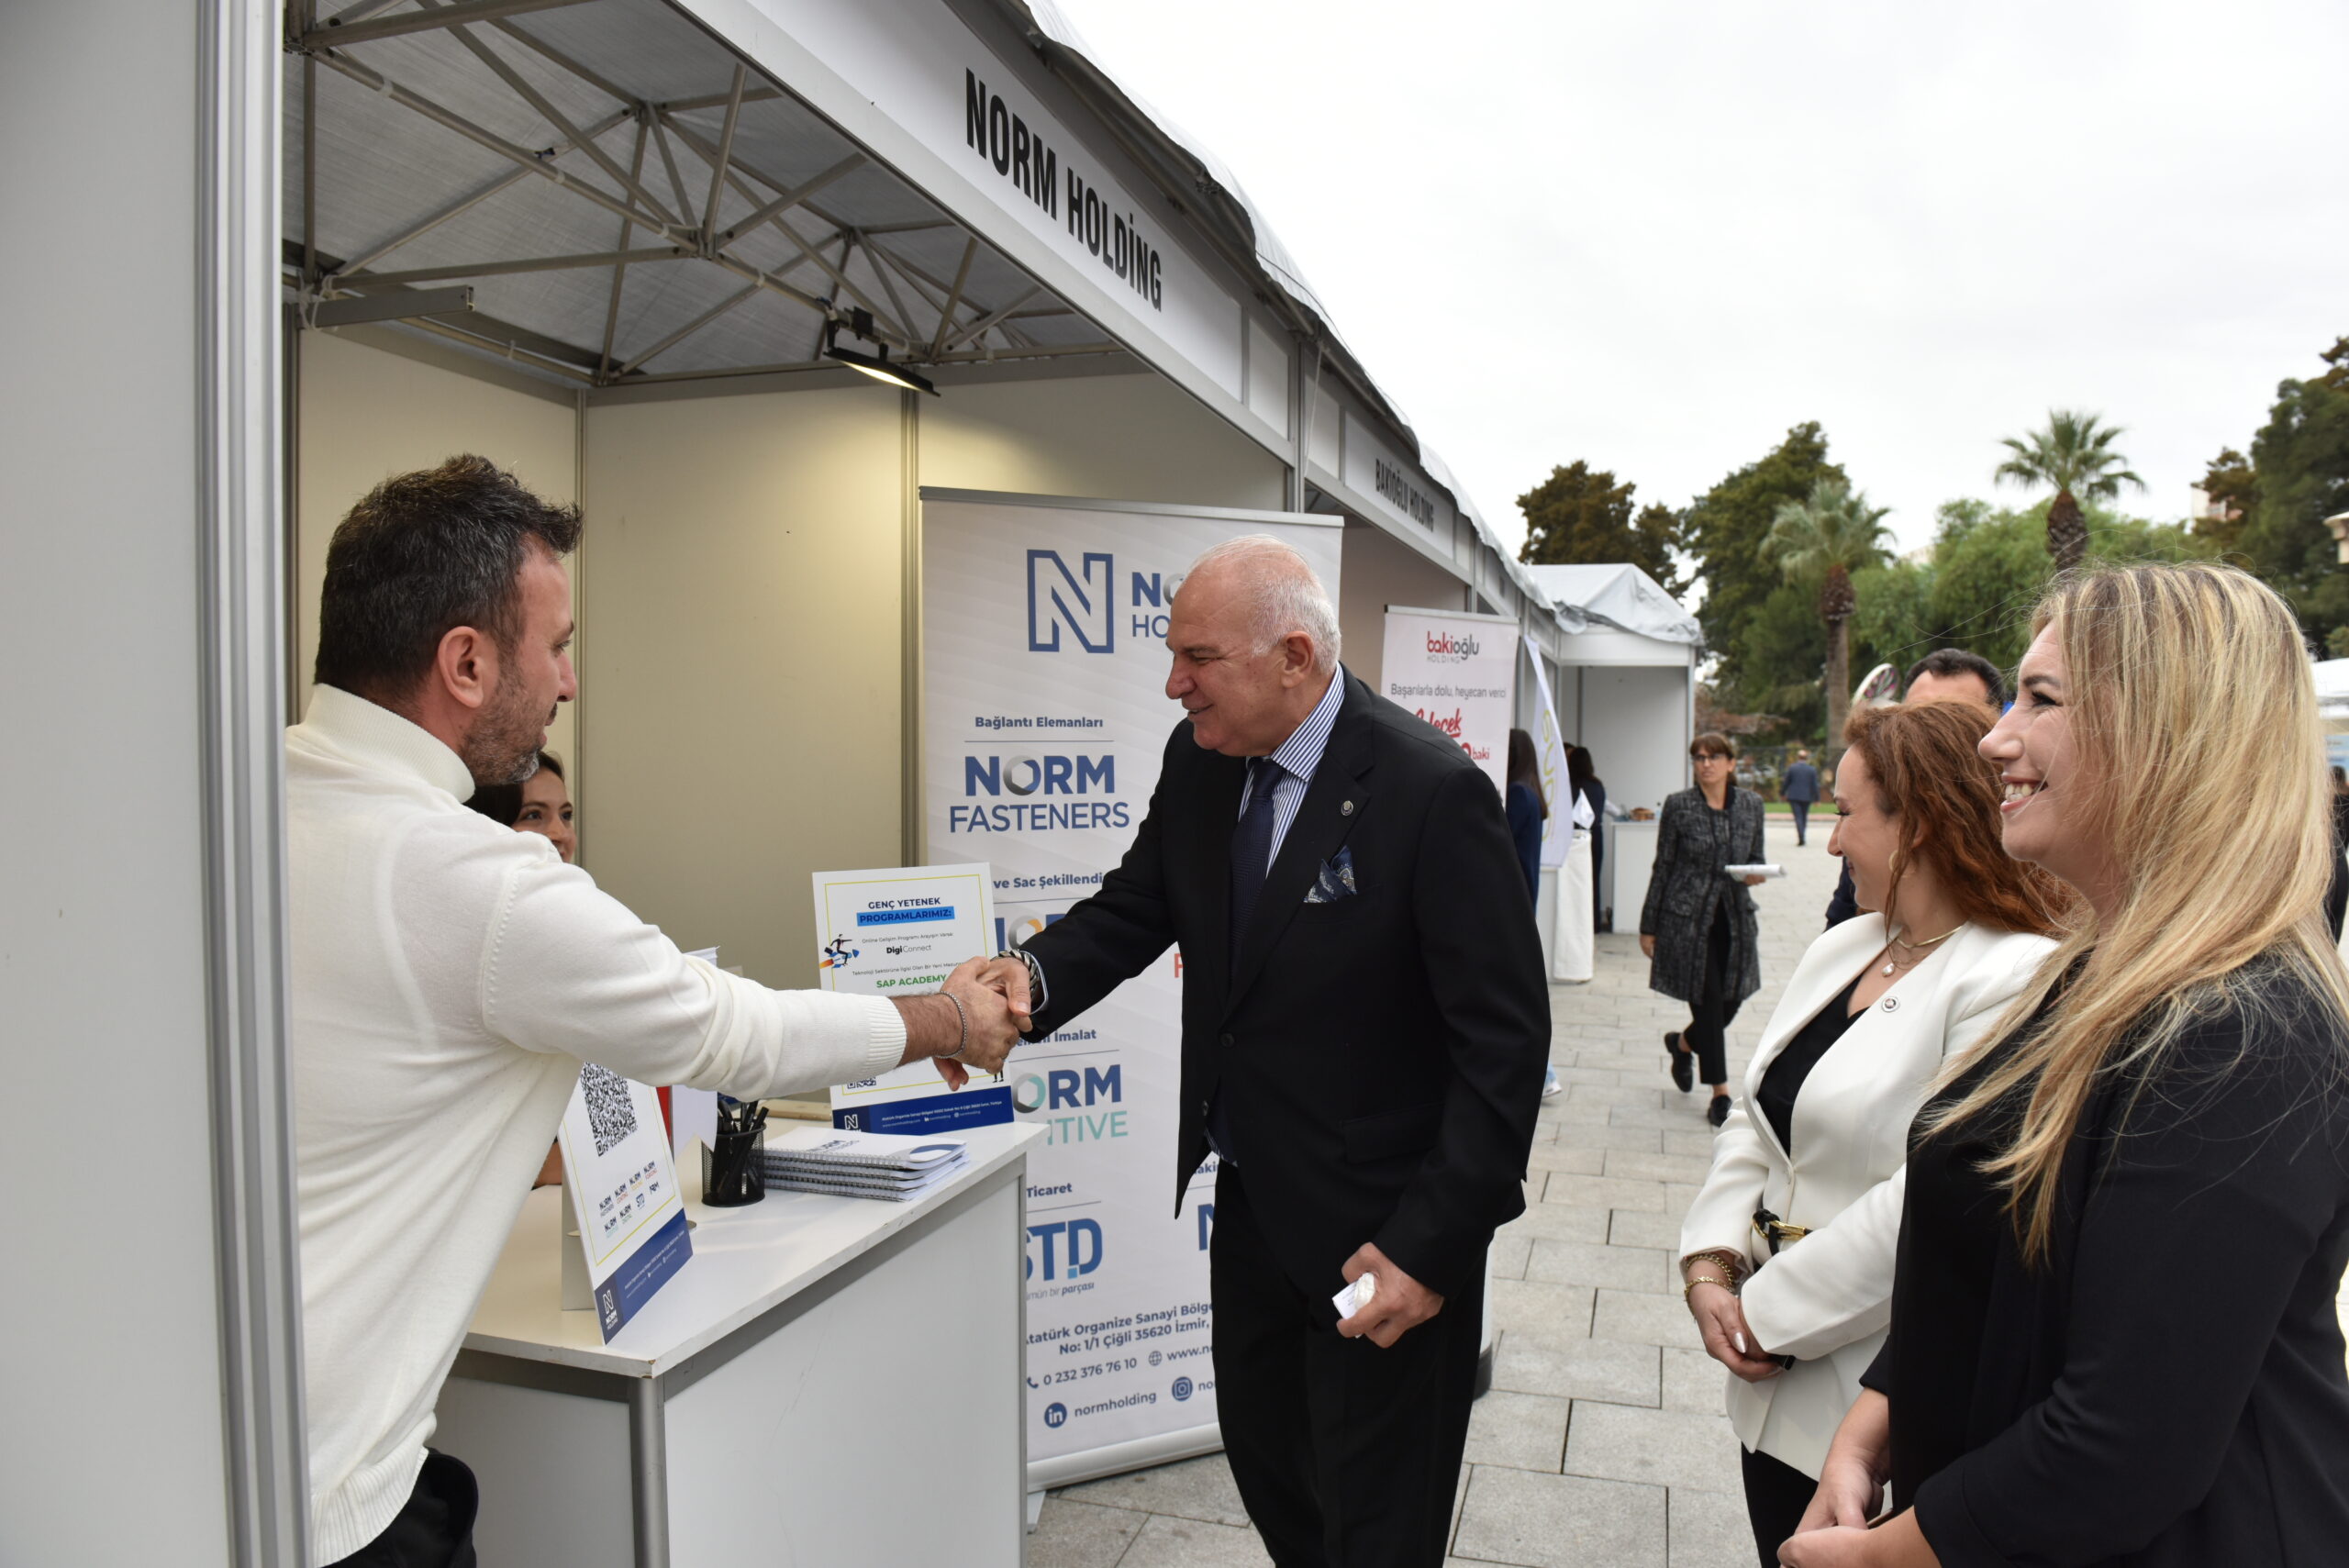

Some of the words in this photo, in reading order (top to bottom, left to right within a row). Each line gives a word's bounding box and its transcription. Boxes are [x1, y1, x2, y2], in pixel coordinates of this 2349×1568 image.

[966, 67, 1056, 221] NORM
[1067, 166, 1162, 312] HOLDİNG
[1427, 630, 1479, 661] bakioğlu
[1455, 685, 1486, 700] heyecan
[974, 716, 1033, 730] Bağlantı
[1036, 716, 1104, 729] Elemanları
[1473, 747, 1490, 761] baki
[964, 754, 1115, 796] NORM
[950, 801, 1130, 833] FASTENERS
[994, 879, 1010, 889] ve
[1013, 877, 1036, 888] Sac
[1039, 872, 1103, 889] Şekillendi
[868, 900, 896, 910] GENÇ
[896, 897, 941, 907] YETENEK
[860, 908, 952, 923] PROGRAMLARIMIZ:
[876, 979, 896, 988] SAP
[898, 974, 947, 986] ACADEMY
[1013, 1064, 1121, 1113] ORM
[1027, 1183, 1073, 1198] Ticaret
[1062, 1282, 1095, 1297] parçası
[1074, 1316, 1132, 1337] Organize
[1136, 1307, 1177, 1325] Sanayi
[1059, 1341, 1081, 1355] No:
[1085, 1336, 1100, 1351] 1/1
[1103, 1330, 1131, 1350] Çiğli
[1135, 1324, 1173, 1341] 35620
[1175, 1318, 1210, 1334] İzmir,
[1043, 1374, 1052, 1386] 0
[1055, 1369, 1077, 1384] 232
[1081, 1363, 1103, 1380] 376
[1106, 1360, 1121, 1374] 76
[1125, 1357, 1138, 1370] 10
[1074, 1391, 1157, 1418] normholding
